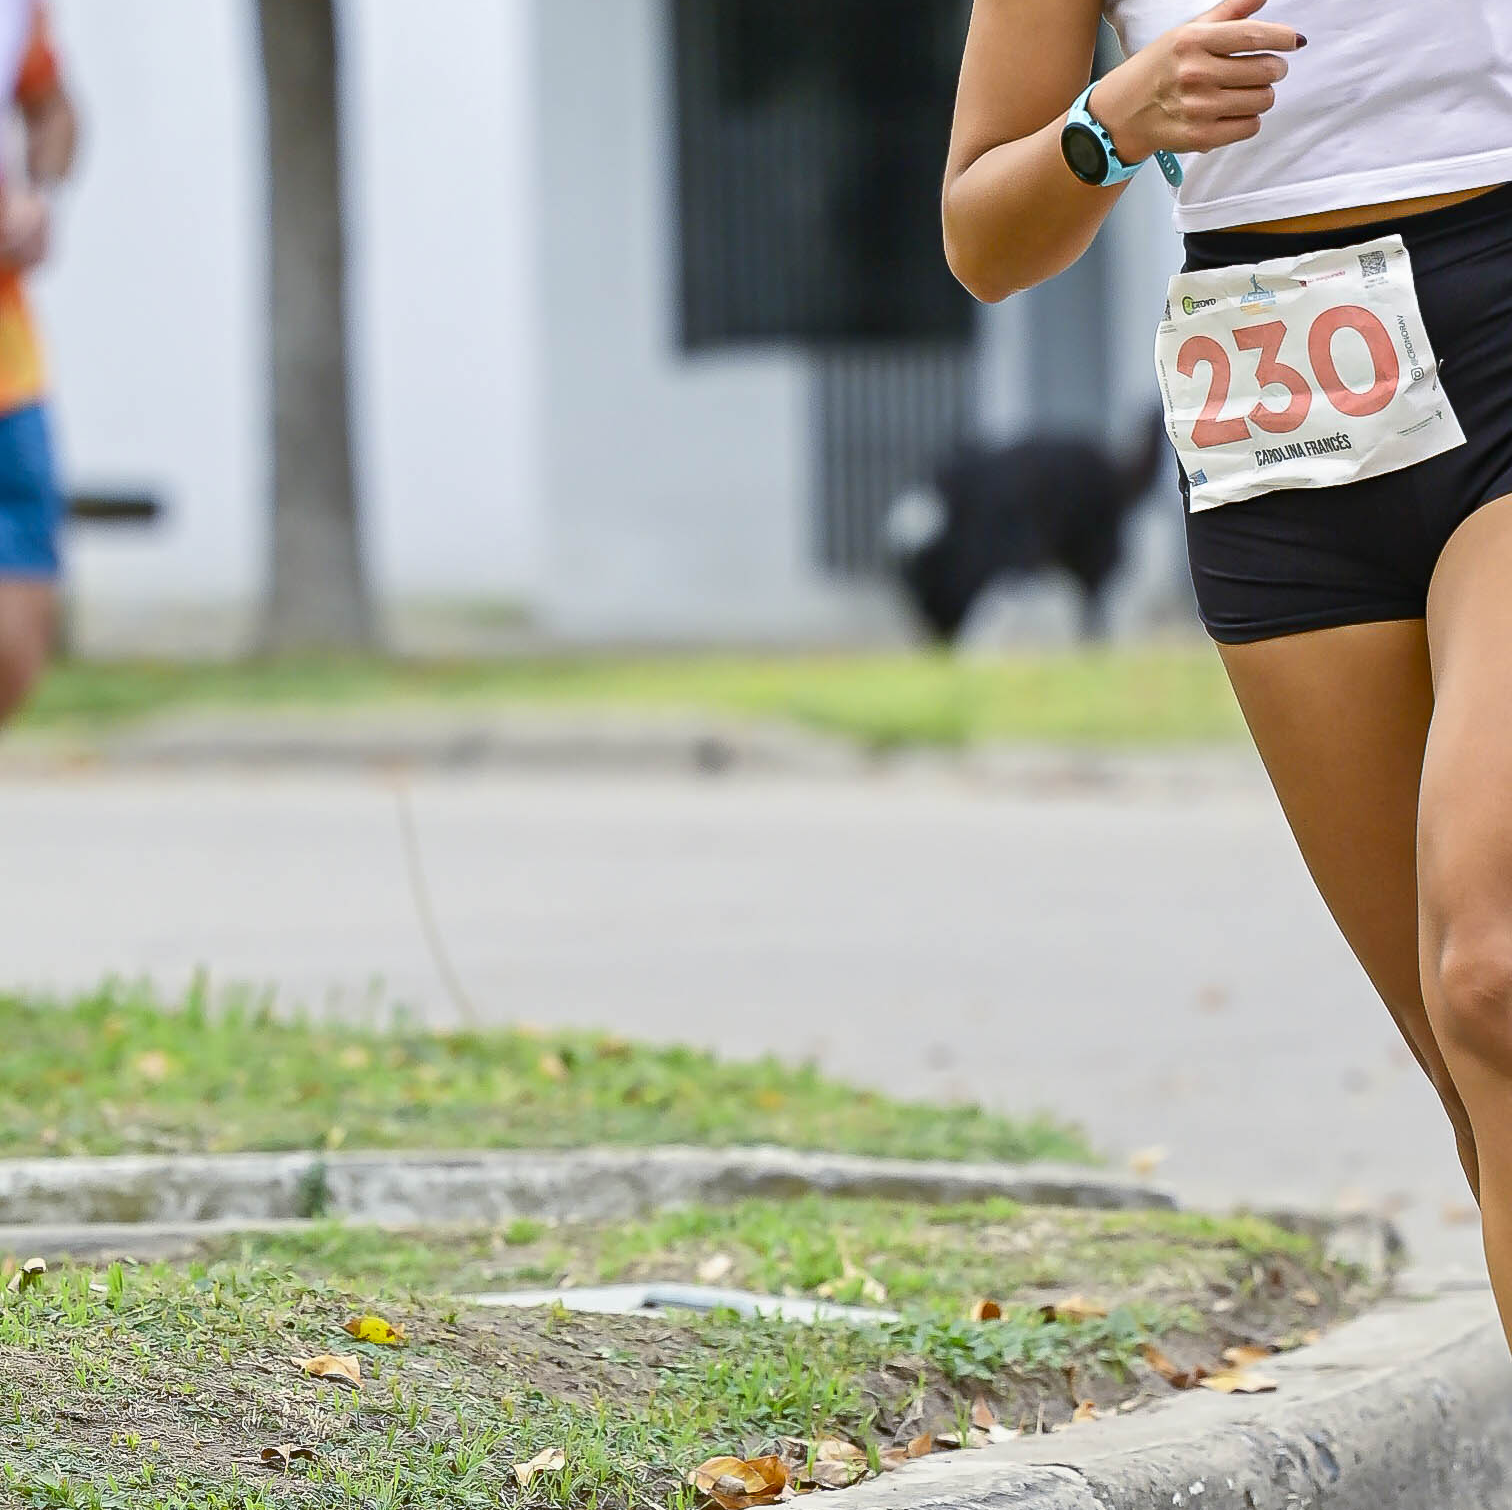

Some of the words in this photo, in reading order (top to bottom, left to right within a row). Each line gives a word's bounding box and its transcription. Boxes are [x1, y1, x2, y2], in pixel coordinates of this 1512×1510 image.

[1176, 304, 1400, 449] 230
[1255, 442, 1306, 467] CAROLINA
[1304, 432, 1352, 457] FRANCÉS
